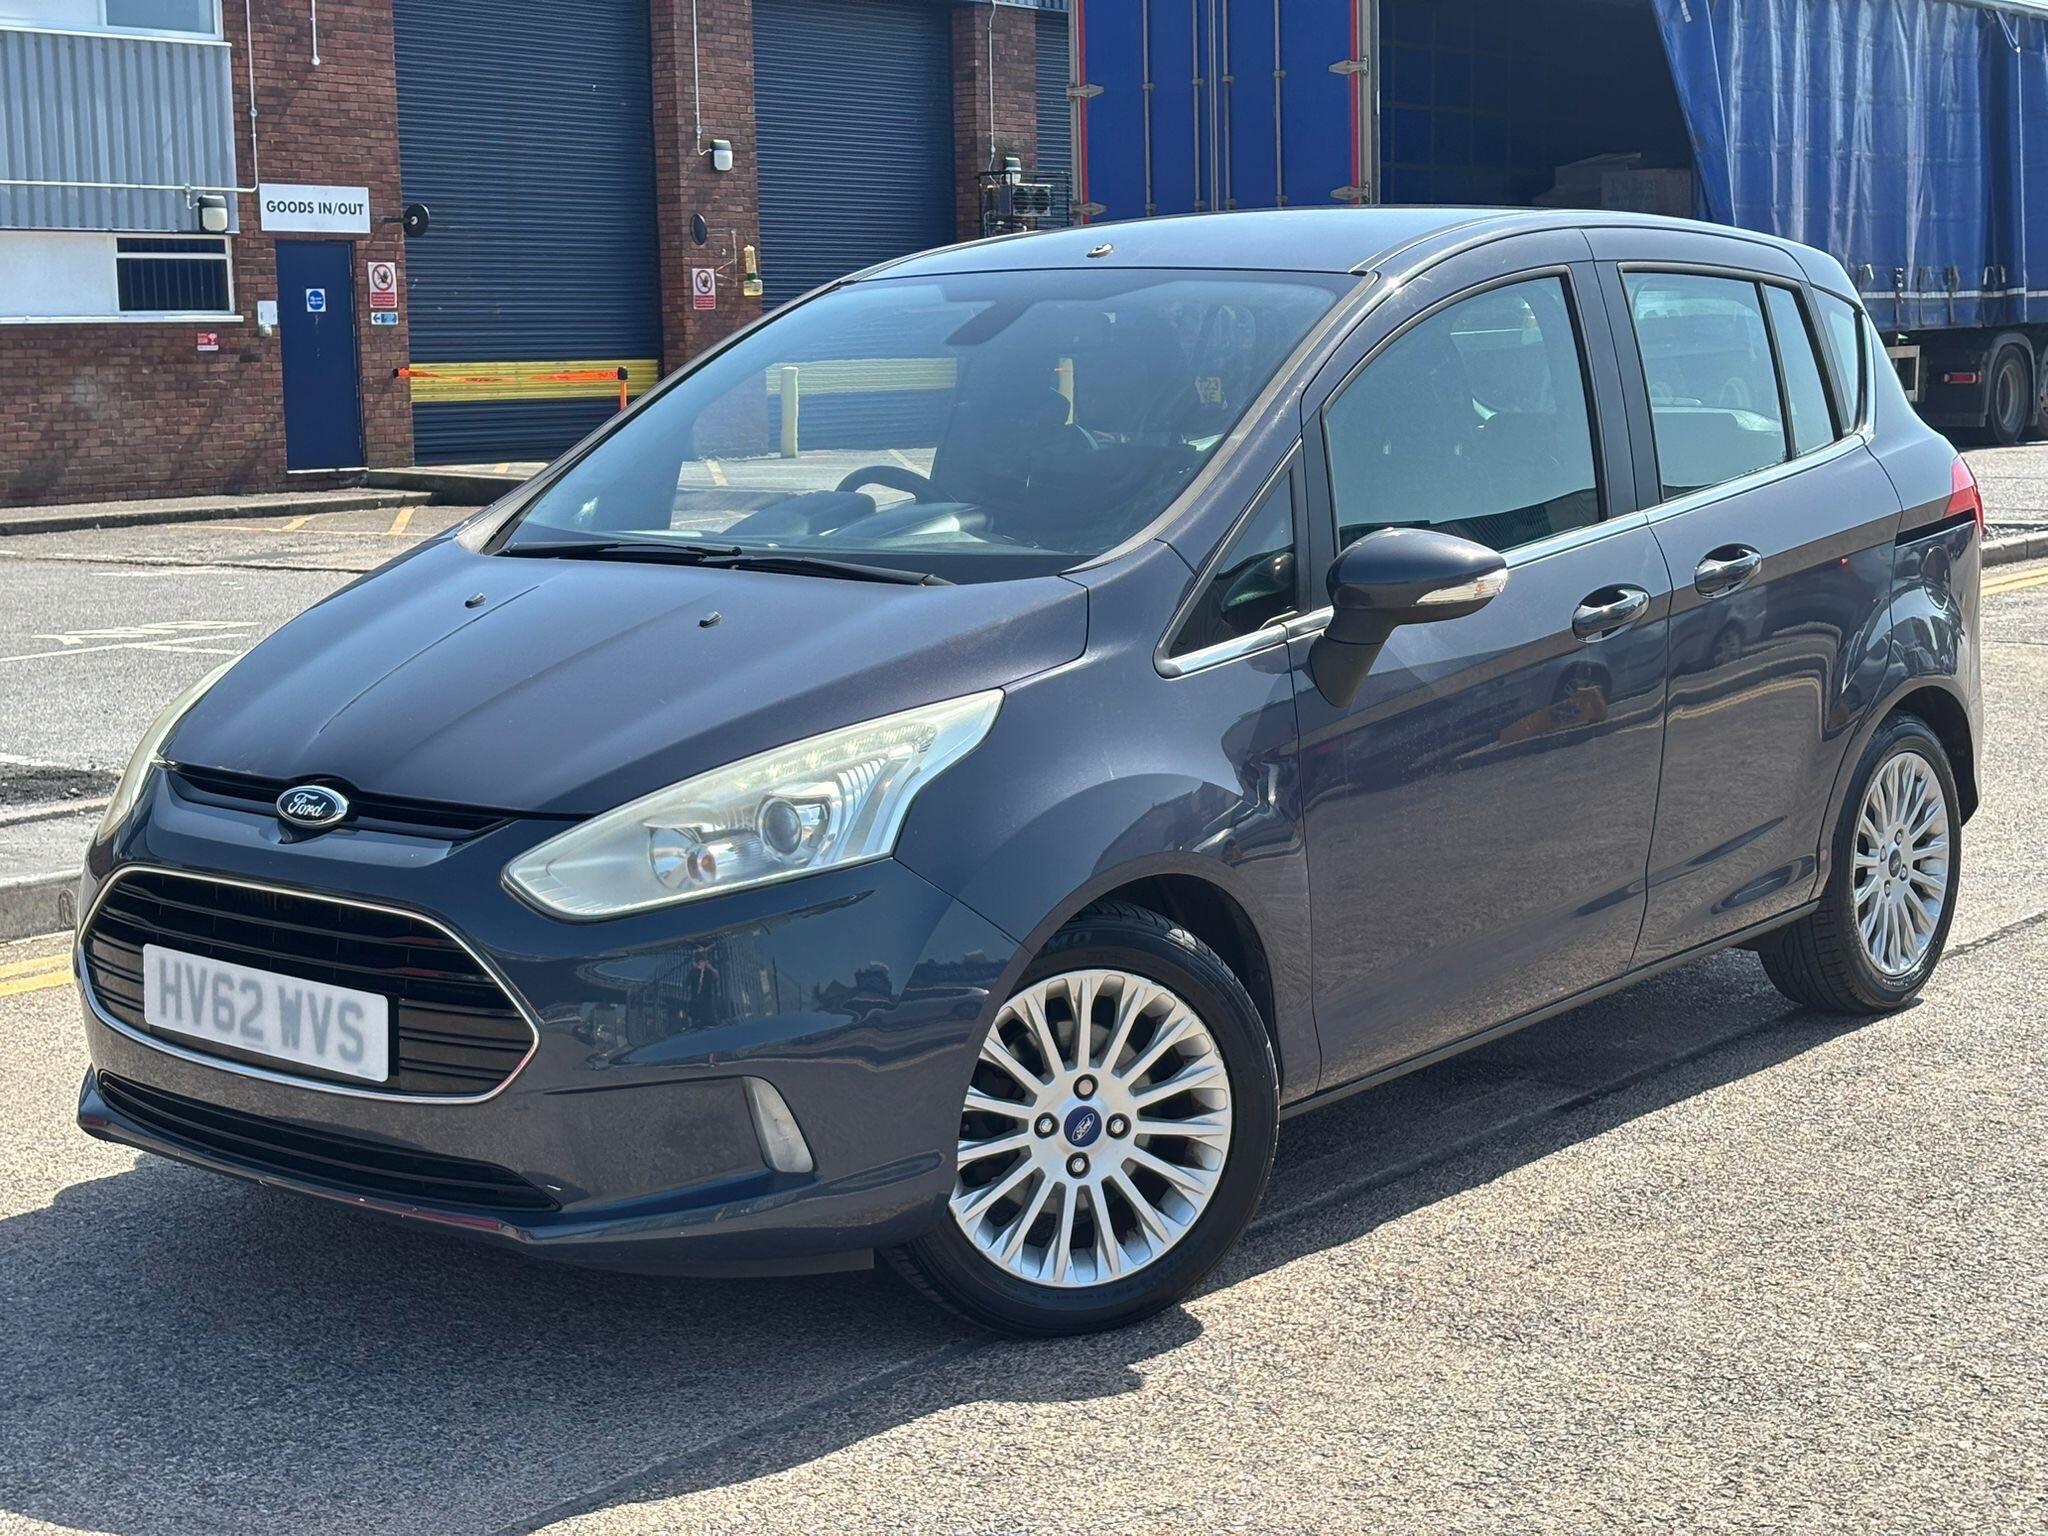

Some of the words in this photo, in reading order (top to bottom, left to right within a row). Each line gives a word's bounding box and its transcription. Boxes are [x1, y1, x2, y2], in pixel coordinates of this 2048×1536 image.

[266, 200, 314, 214] GOODS
[318, 202, 364, 216] IN/OUT
[287, 792, 327, 817] Ford
[158, 957, 264, 1041] HV62
[277, 984, 365, 1064] WVS
